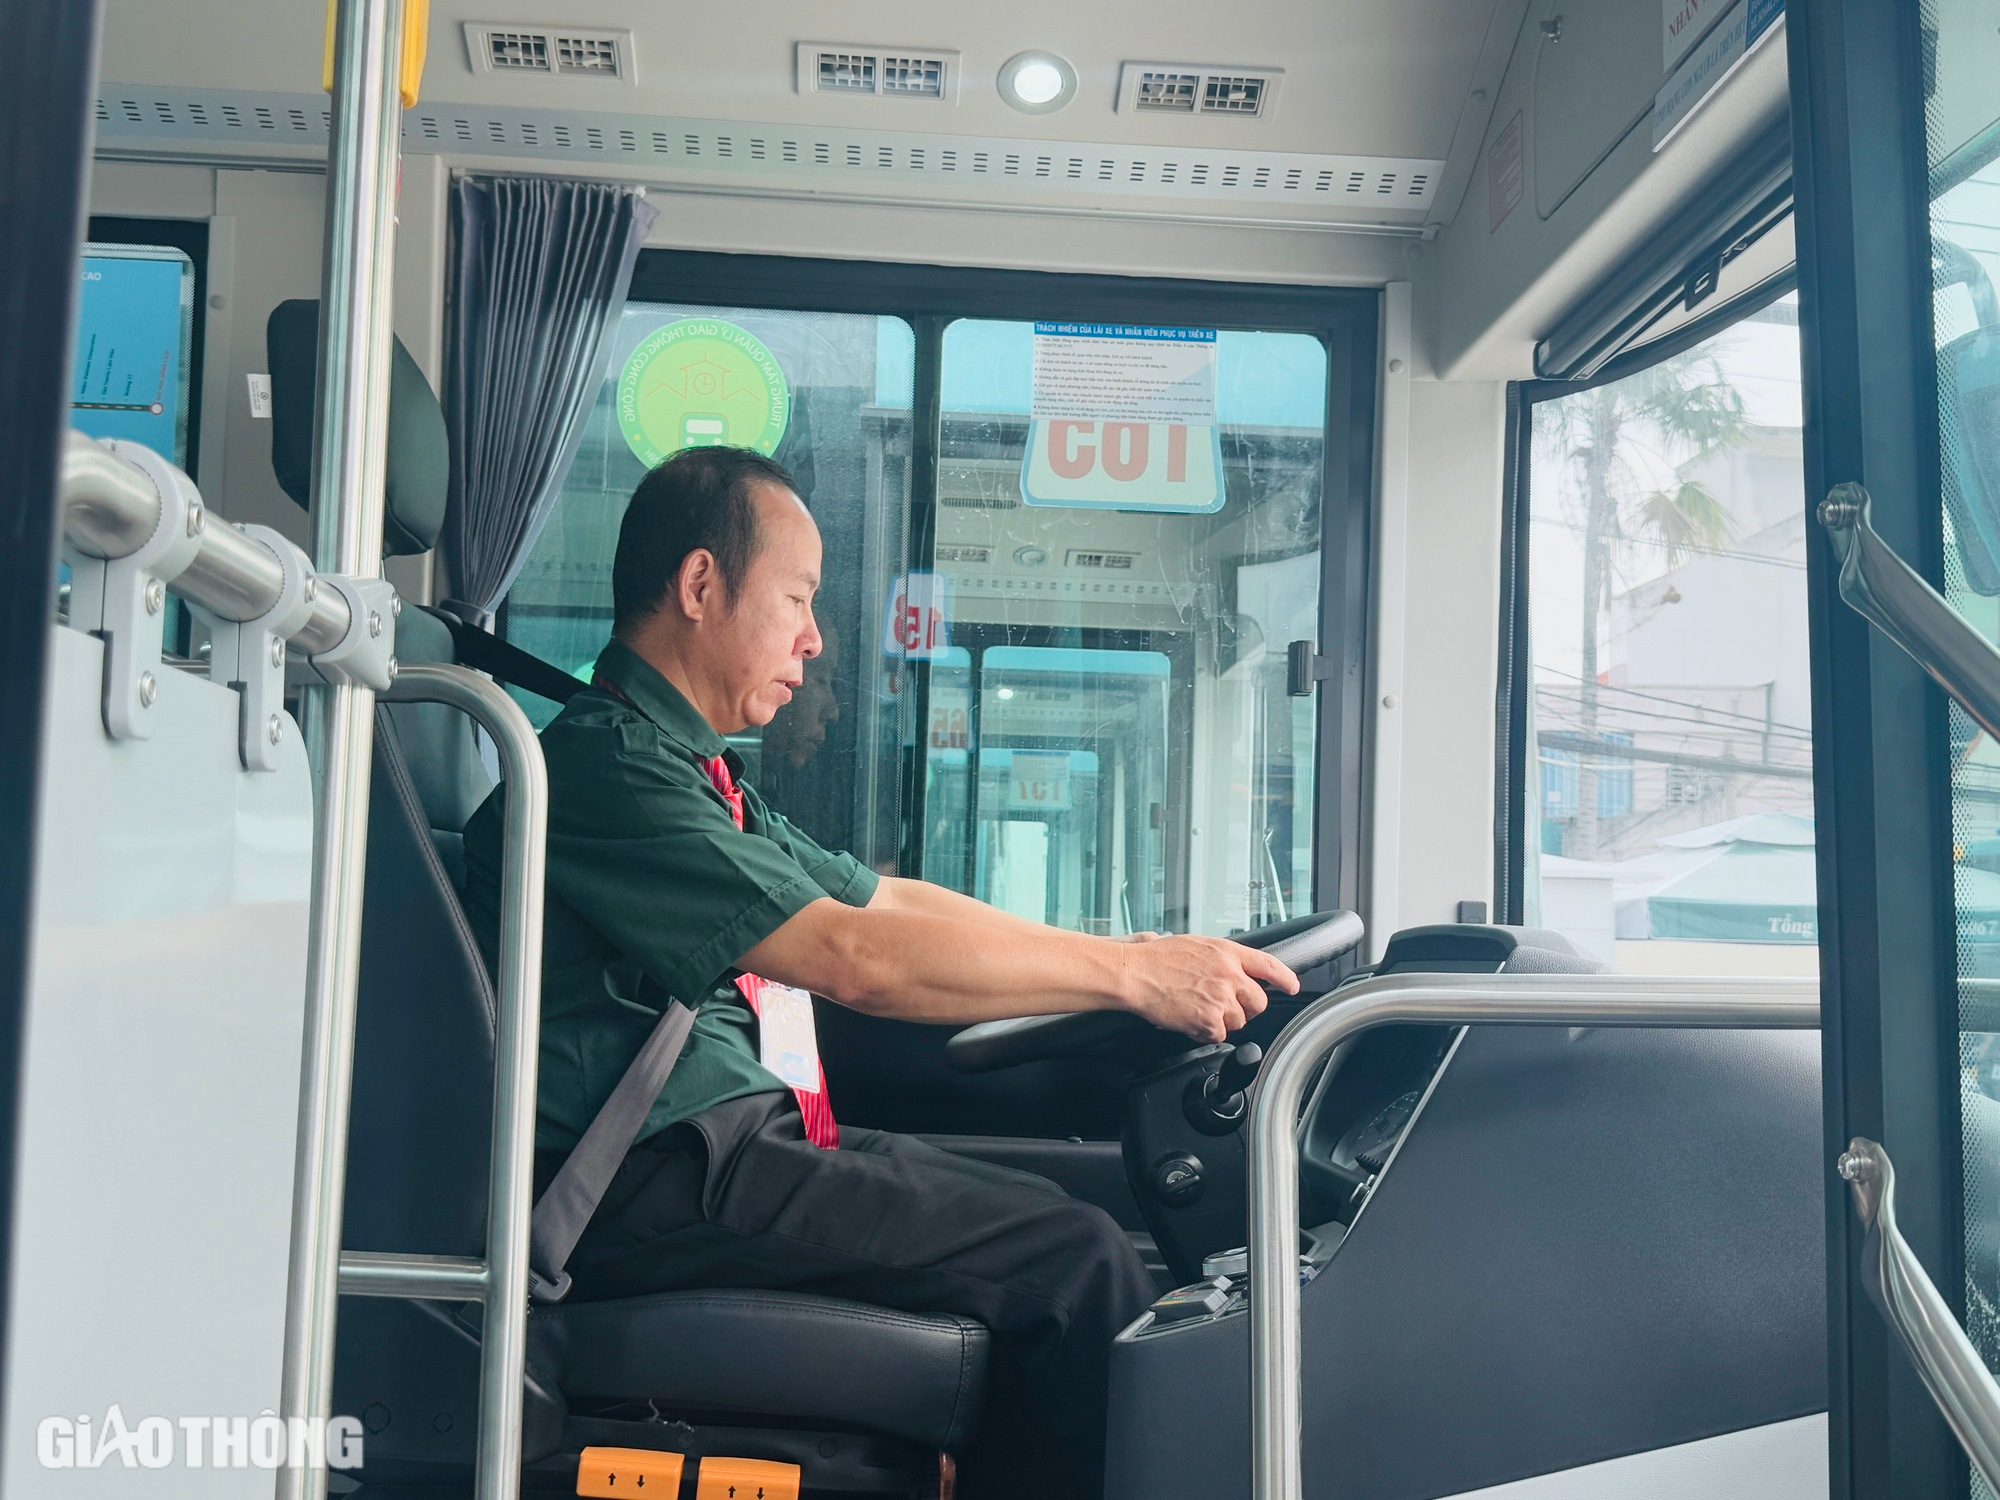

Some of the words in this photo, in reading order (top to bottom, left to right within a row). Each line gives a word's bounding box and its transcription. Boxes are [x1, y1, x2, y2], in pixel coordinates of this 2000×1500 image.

[1035, 322, 1056, 332] TRÁCH
[1057, 324, 1078, 334] NHIỆM
[1079, 324, 1092, 334] CỦA
[1093, 324, 1103, 334] LÁI
[1105, 327, 1113, 335] XE
[1114, 325, 1123, 335] VÀ
[1124, 327, 1142, 336] NHÂN
[1143, 328, 1158, 337] VIÊN
[1159, 329, 1176, 338] PHỤC
[1177, 330, 1187, 339] VỤ
[1188, 329, 1204, 339] TRÊN
[1205, 331, 1214, 339] XE
[1768, 912, 1814, 937] Tổng
